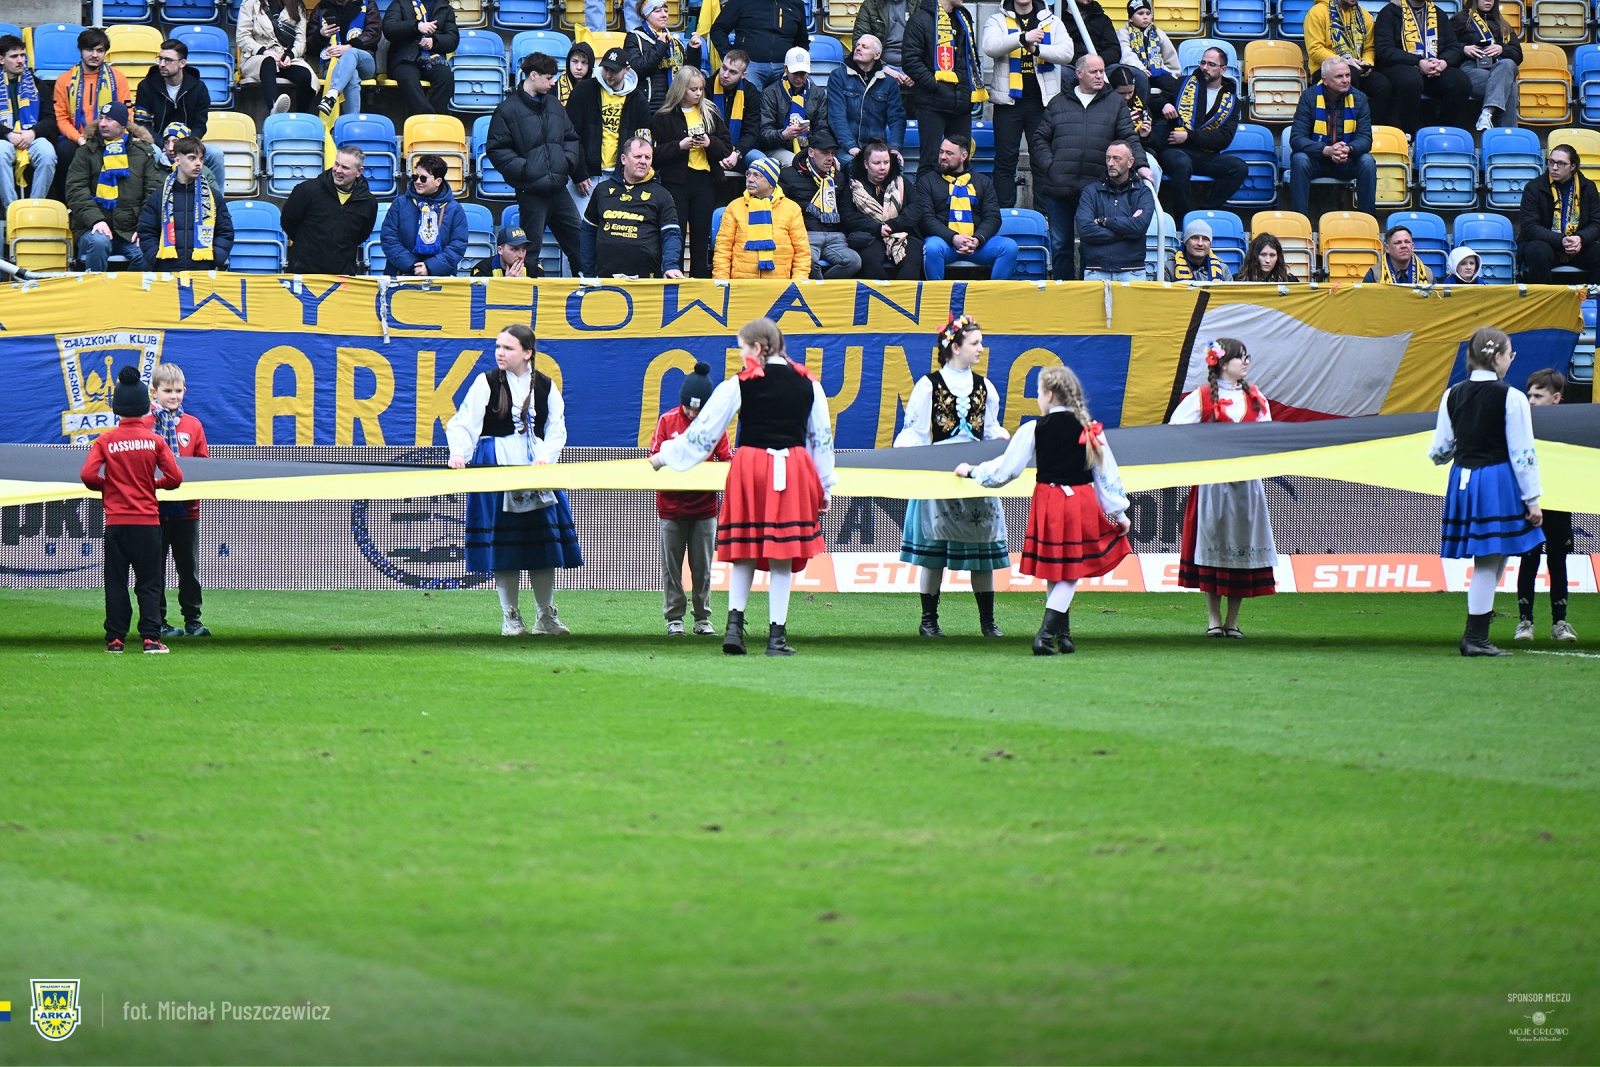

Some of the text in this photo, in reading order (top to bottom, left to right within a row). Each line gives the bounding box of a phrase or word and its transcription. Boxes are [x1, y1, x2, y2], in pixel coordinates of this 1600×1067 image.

[611, 223, 638, 233] Energa
[129, 334, 158, 346] KLUB
[66, 361, 81, 402] MORSKI
[107, 439, 156, 454] CASSUBIAN
[1313, 564, 1432, 588] STIHL
